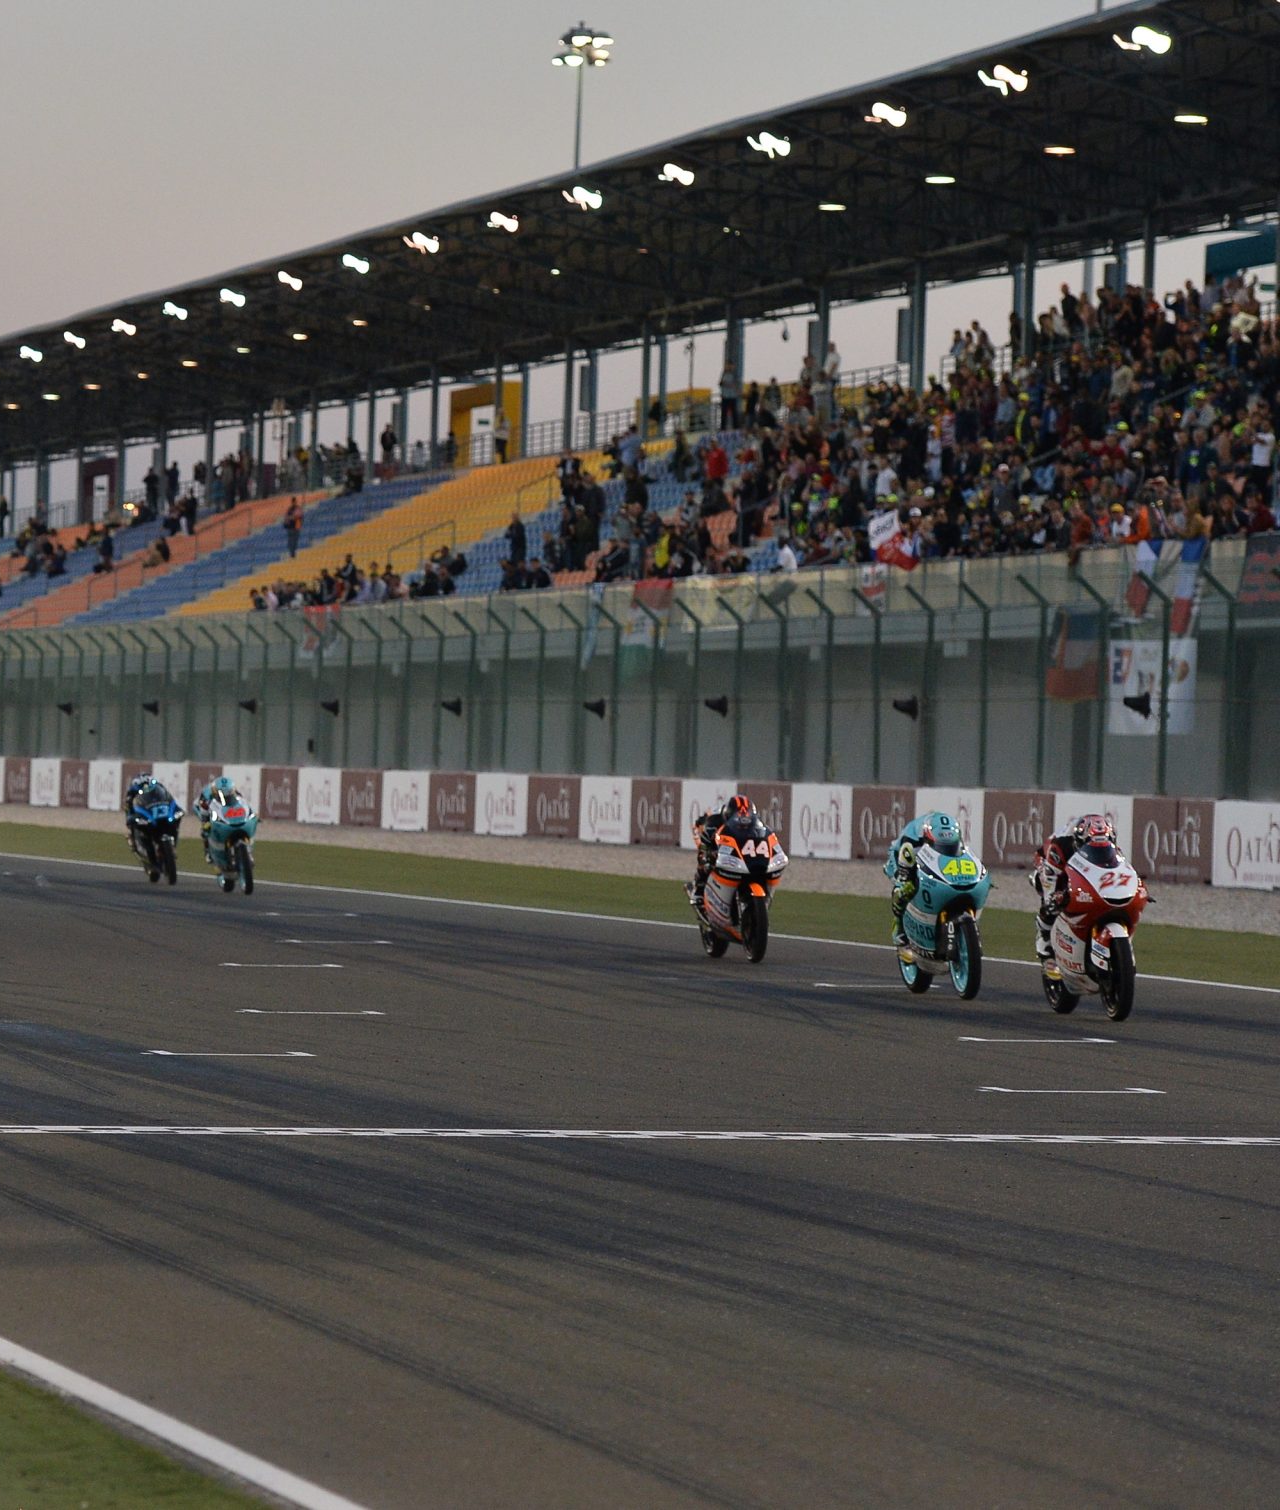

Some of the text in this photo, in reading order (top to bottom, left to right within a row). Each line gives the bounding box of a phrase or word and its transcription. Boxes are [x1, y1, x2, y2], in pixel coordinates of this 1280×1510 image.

[151, 805, 170, 818] 13
[800, 804, 842, 849] QATAR
[992, 811, 1044, 862] QATAR
[741, 839, 771, 858] 44
[1143, 819, 1201, 874] QATAR
[942, 859, 977, 876] 48
[1099, 871, 1132, 889] 27
